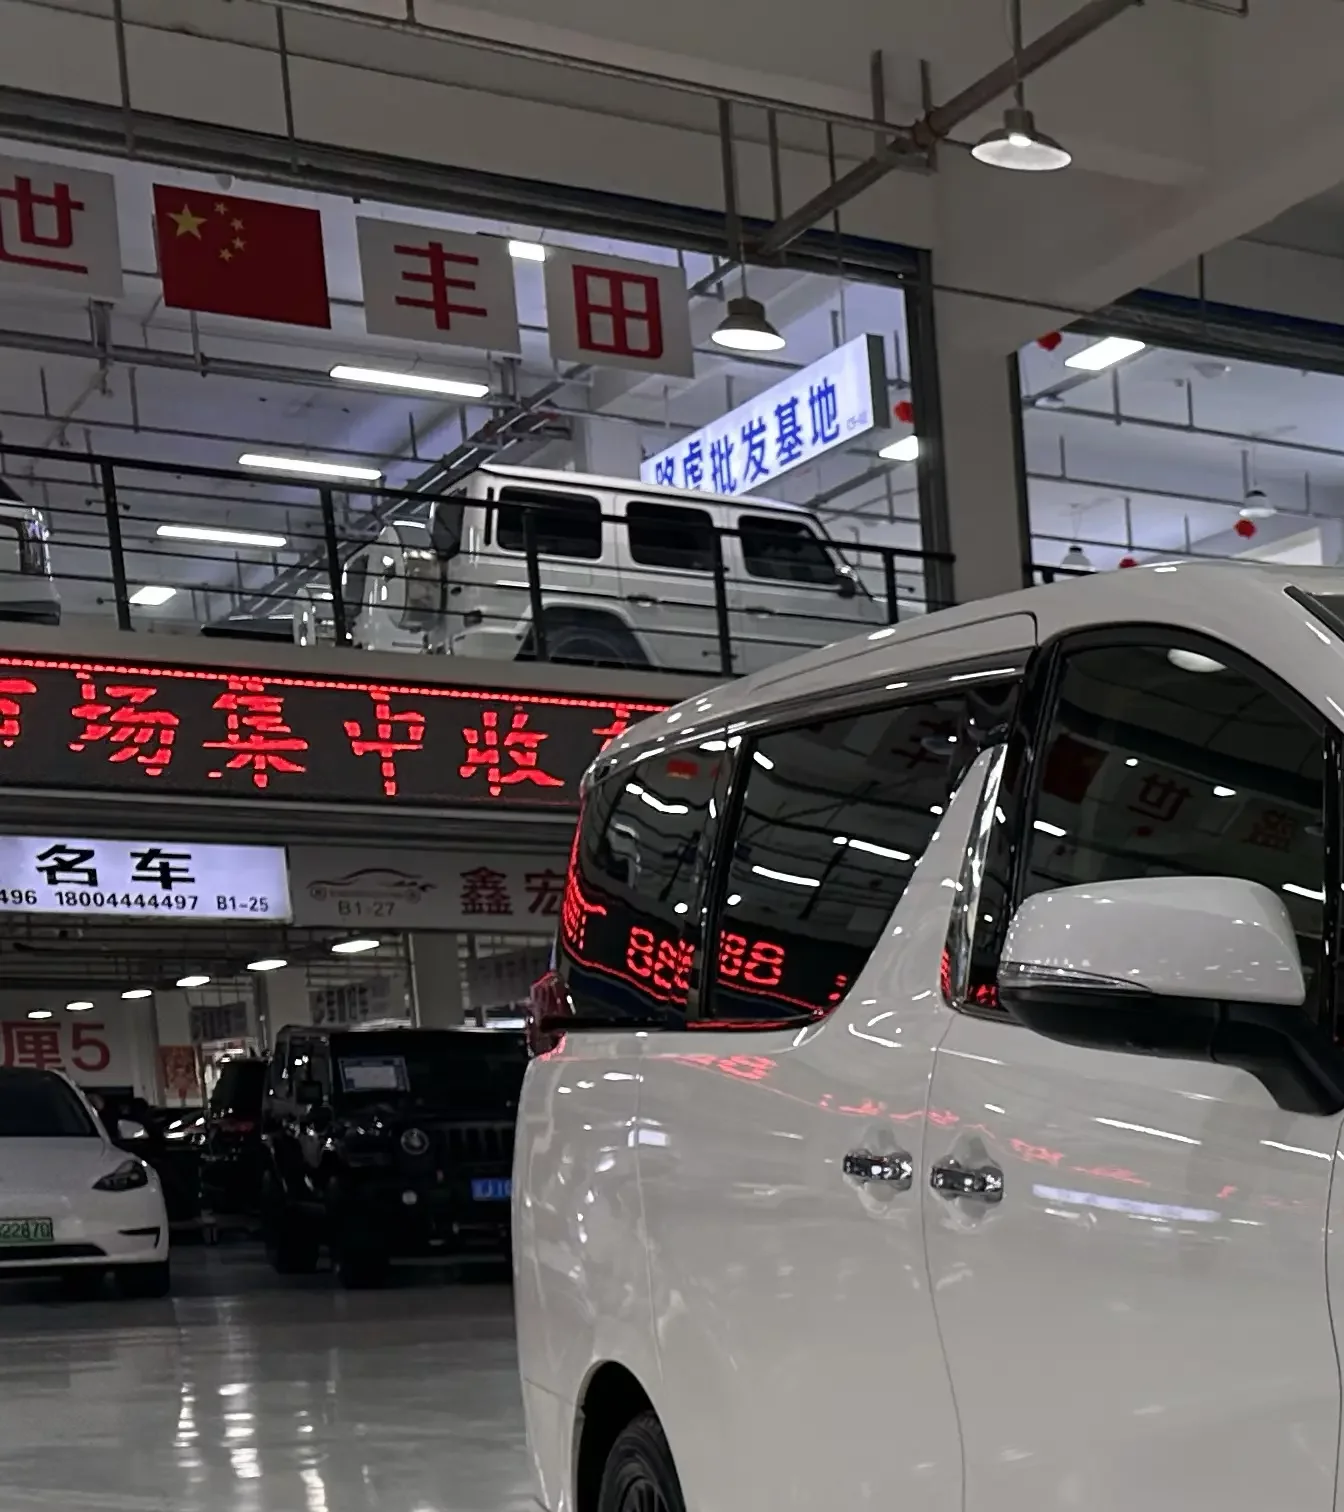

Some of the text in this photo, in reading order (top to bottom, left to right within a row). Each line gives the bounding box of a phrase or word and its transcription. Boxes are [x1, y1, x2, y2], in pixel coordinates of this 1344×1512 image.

[0, 176, 89, 274] 世
[54, 891, 199, 911] 18004444497
[216, 896, 269, 912] B1-25
[0, 1223, 51, 1239] 22870
